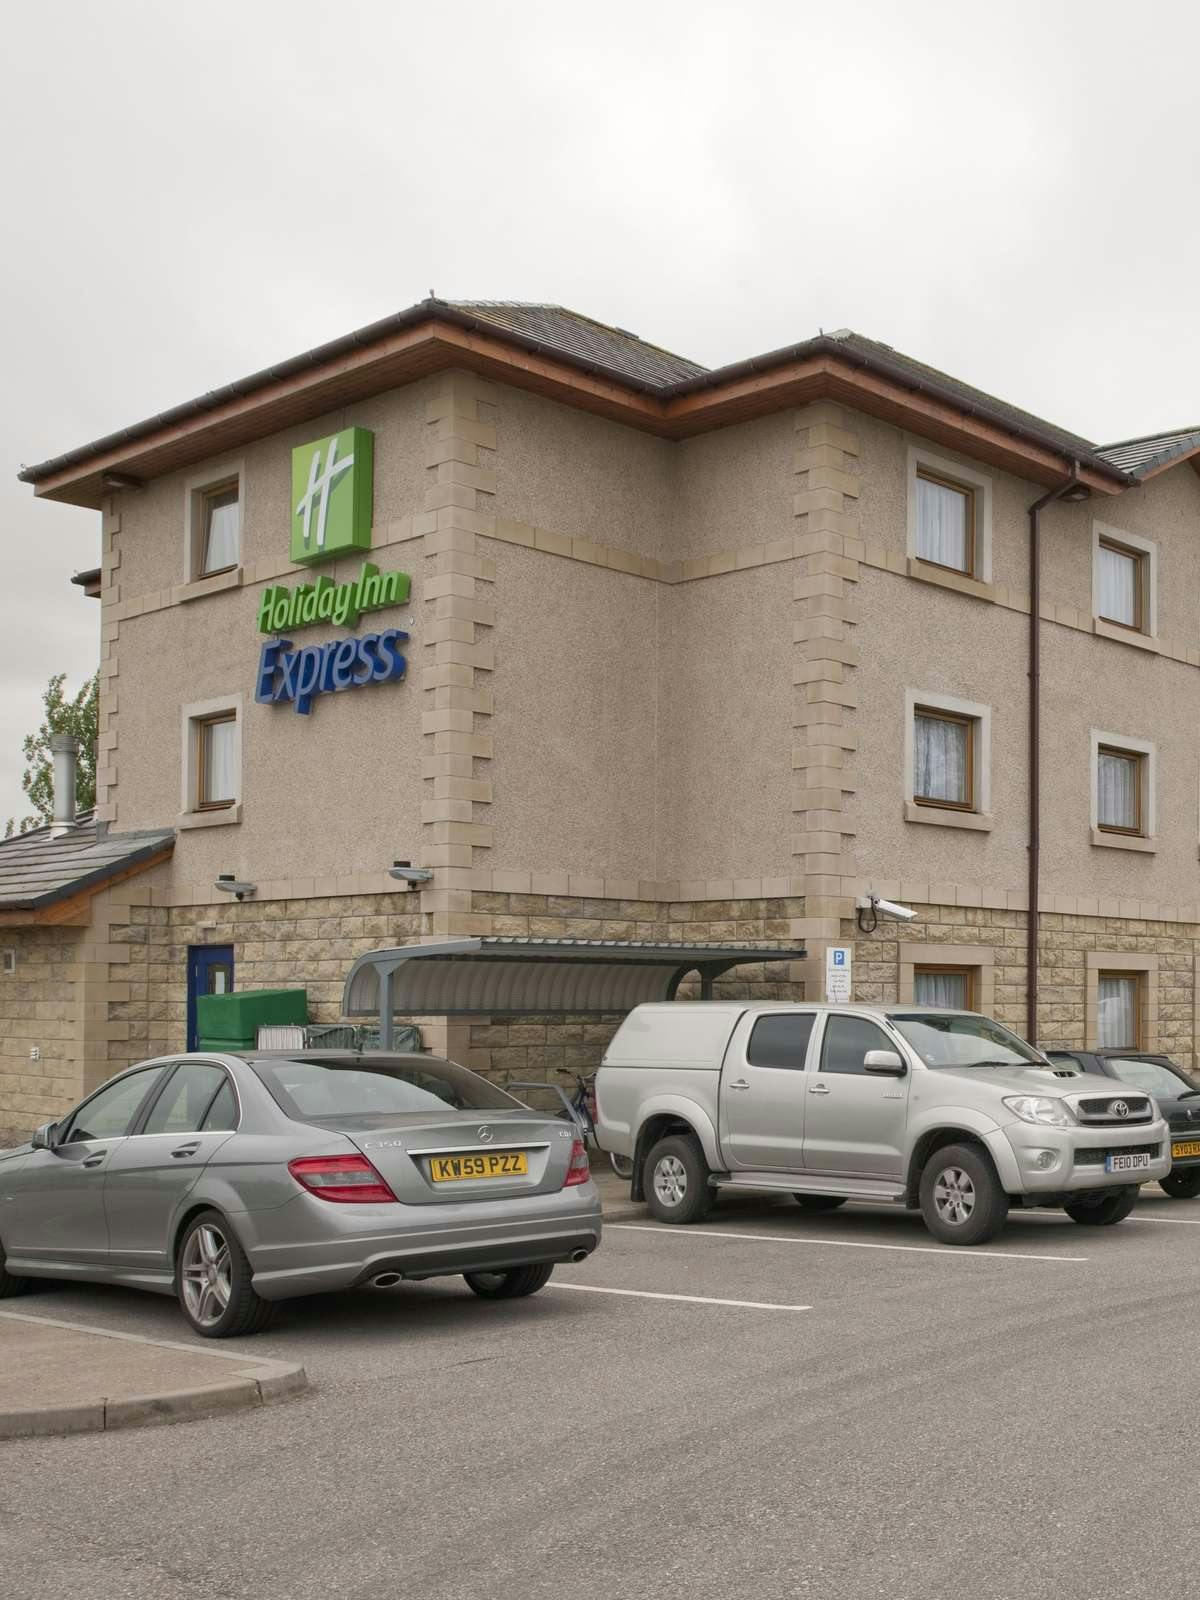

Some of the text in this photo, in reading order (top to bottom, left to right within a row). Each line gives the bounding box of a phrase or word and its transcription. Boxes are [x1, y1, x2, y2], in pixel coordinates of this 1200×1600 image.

[256, 562, 406, 633] Holiday Inn
[254, 629, 409, 716] Express
[835, 952, 843, 964] P
[438, 1155, 522, 1177] KW59 PZZ
[1113, 1154, 1148, 1169] FE10 DPU
